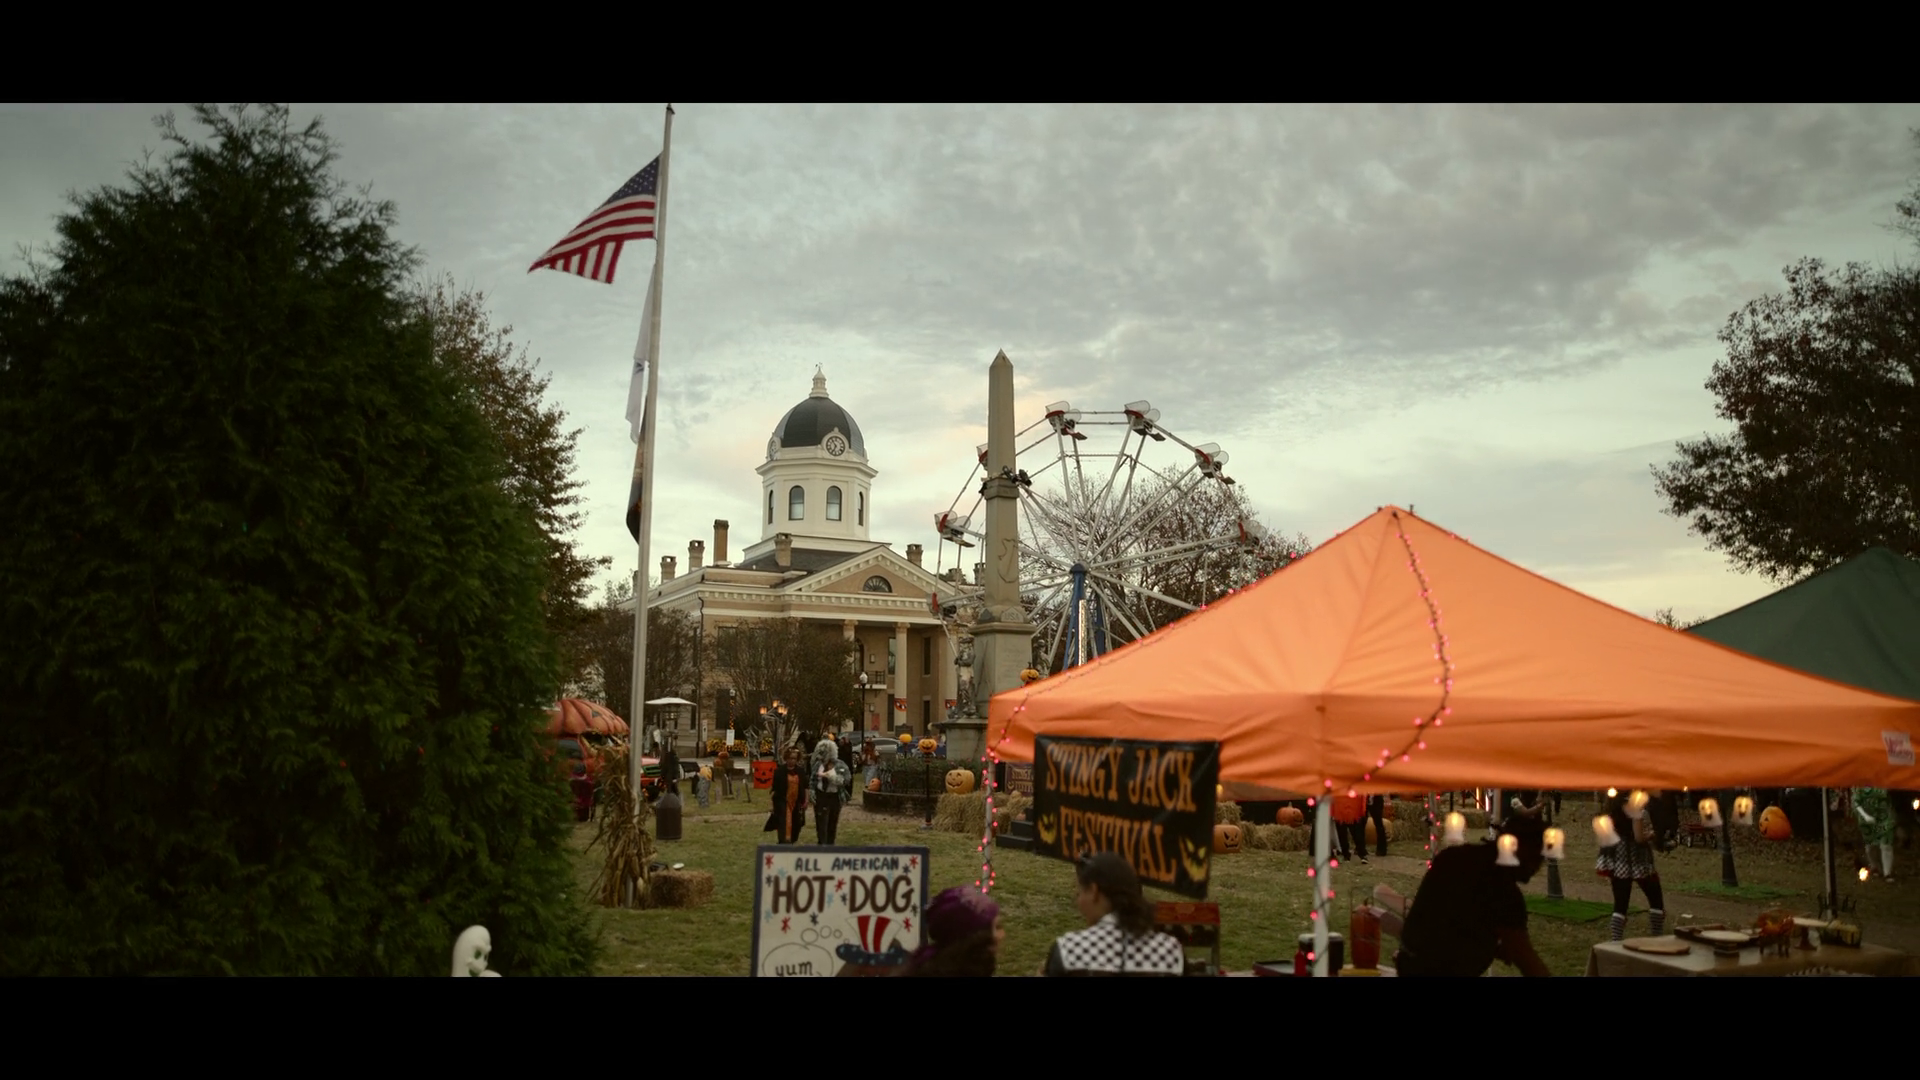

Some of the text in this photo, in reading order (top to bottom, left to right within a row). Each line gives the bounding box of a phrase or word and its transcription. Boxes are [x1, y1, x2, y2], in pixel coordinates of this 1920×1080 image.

[1046, 743, 1196, 812] STINGY JACK
[794, 856, 899, 871] ALL AMERICAN
[1060, 805, 1176, 883] FESTIVAL
[772, 874, 914, 914] HOT DOG
[775, 960, 814, 977] yum
